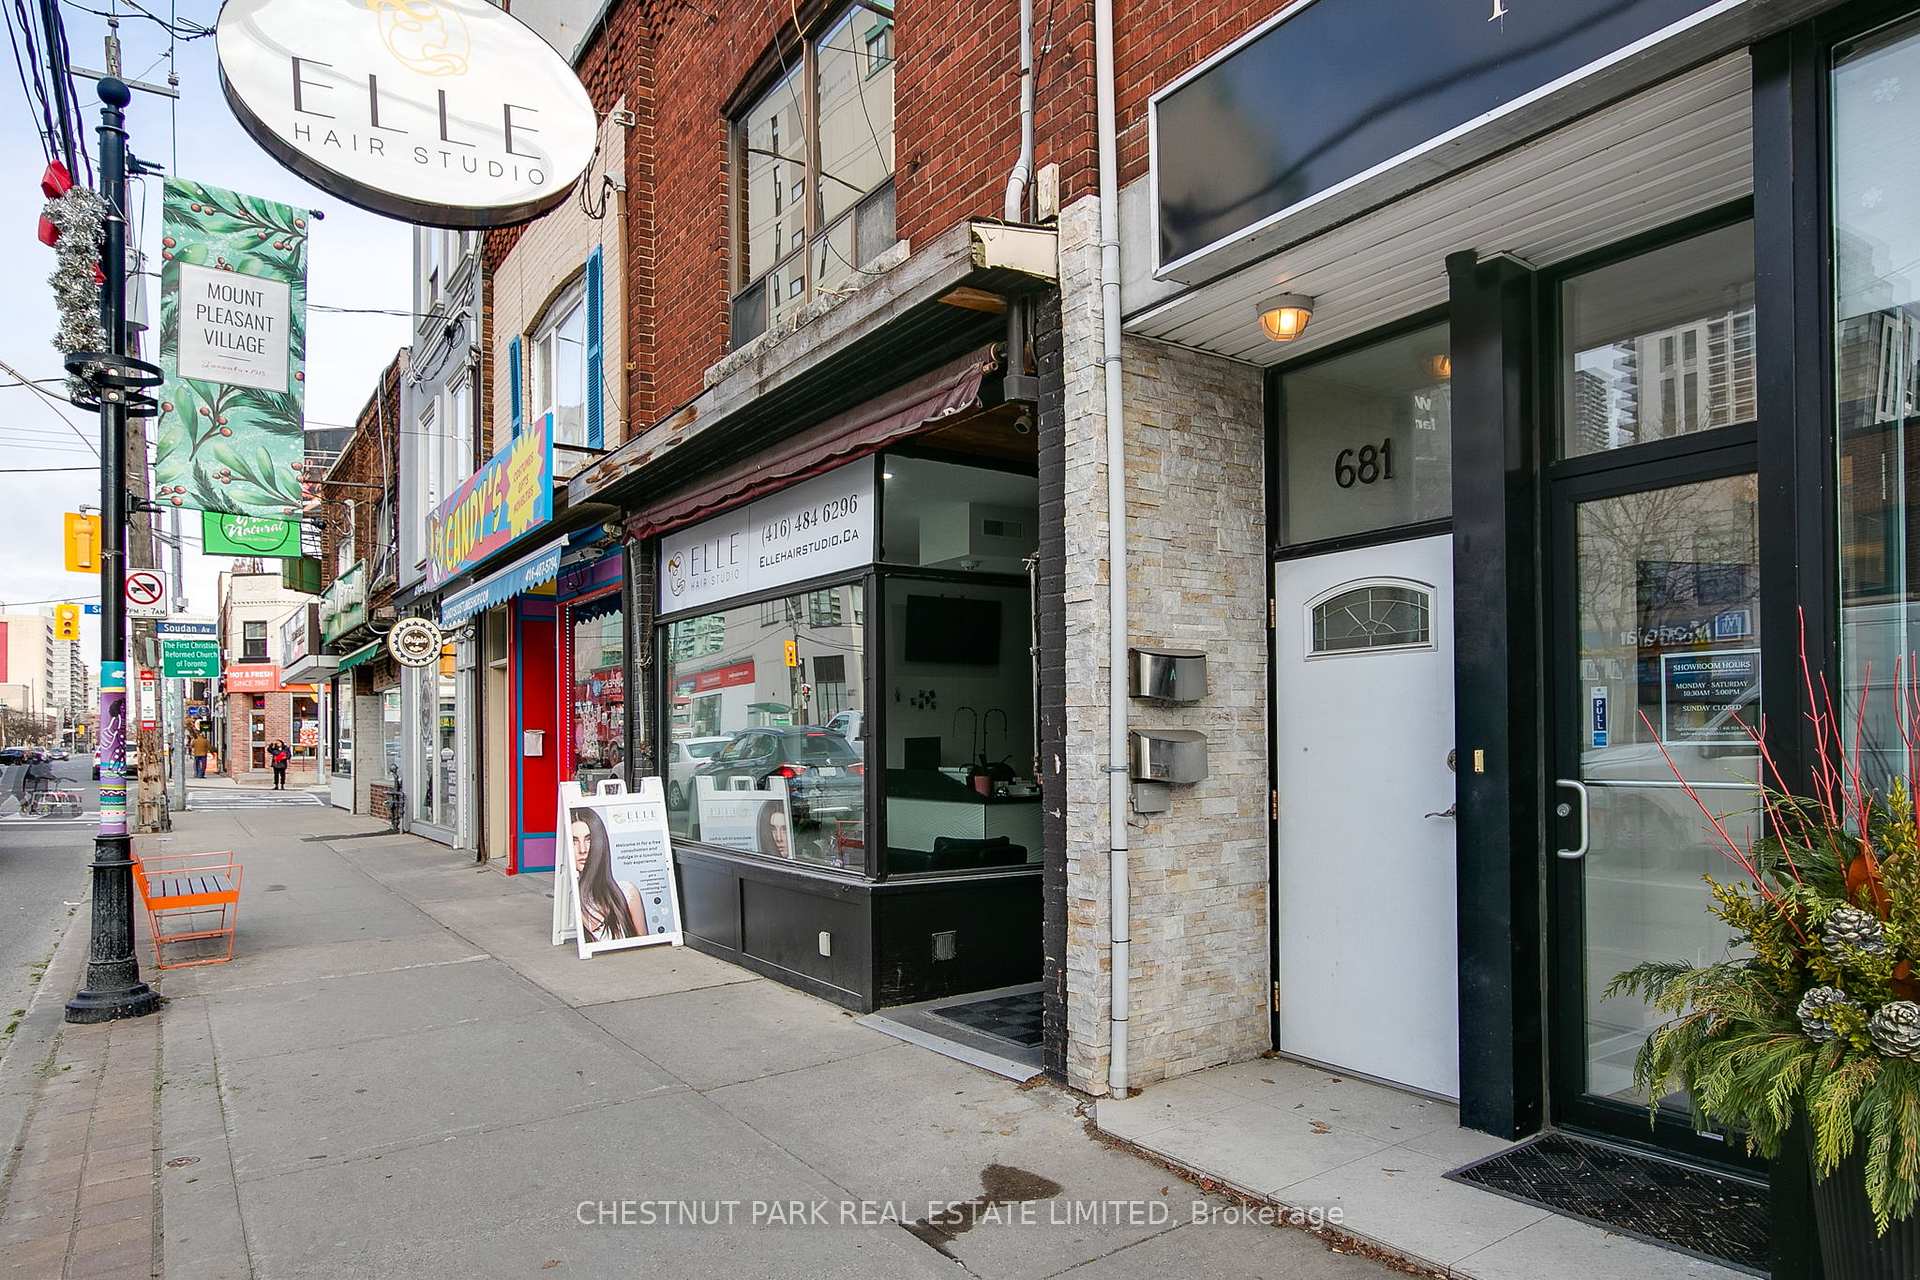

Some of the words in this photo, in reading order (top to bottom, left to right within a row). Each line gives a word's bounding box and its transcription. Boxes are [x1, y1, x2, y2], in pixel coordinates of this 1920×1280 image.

[291, 56, 541, 159] ELLE
[294, 122, 384, 156] HAIR
[414, 147, 545, 185] STUDIO
[207, 282, 265, 308] MOUNT
[196, 303, 274, 333] PLEASANT
[203, 328, 265, 354] VILLAGE
[1334, 438, 1393, 488] 681
[761, 517, 791, 549] (416)
[794, 509, 818, 532] 484
[822, 494, 858, 523] 6296
[691, 532, 740, 577] ELLE
[690, 577, 707, 590] HAIR
[711, 568, 740, 586] STUDIO
[151, 607, 166, 615] 7AM
[163, 624, 197, 633] Soudan
[1672, 662, 1721, 672] SHOWROOM
[1722, 661, 1752, 669] HOURS
